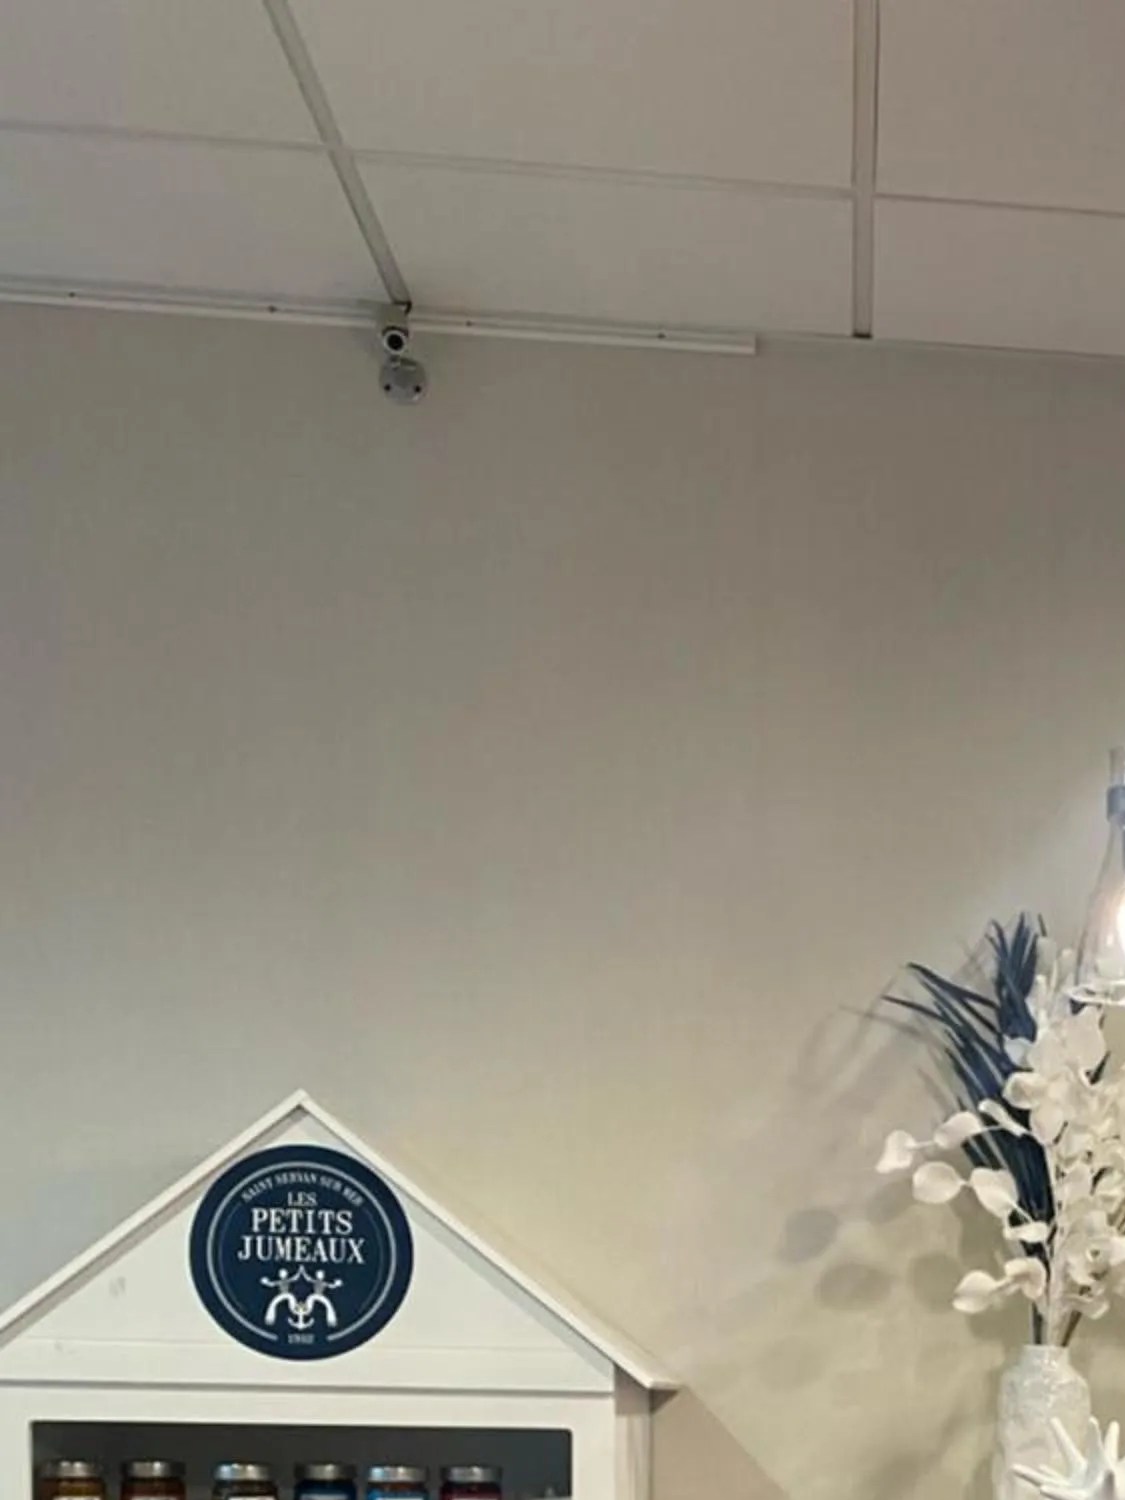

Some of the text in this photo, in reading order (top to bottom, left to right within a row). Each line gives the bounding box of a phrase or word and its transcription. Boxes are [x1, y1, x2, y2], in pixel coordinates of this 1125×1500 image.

[287, 1191, 318, 1207] LES
[251, 1207, 353, 1236] PETITS
[237, 1236, 366, 1264] JUMEAUX
